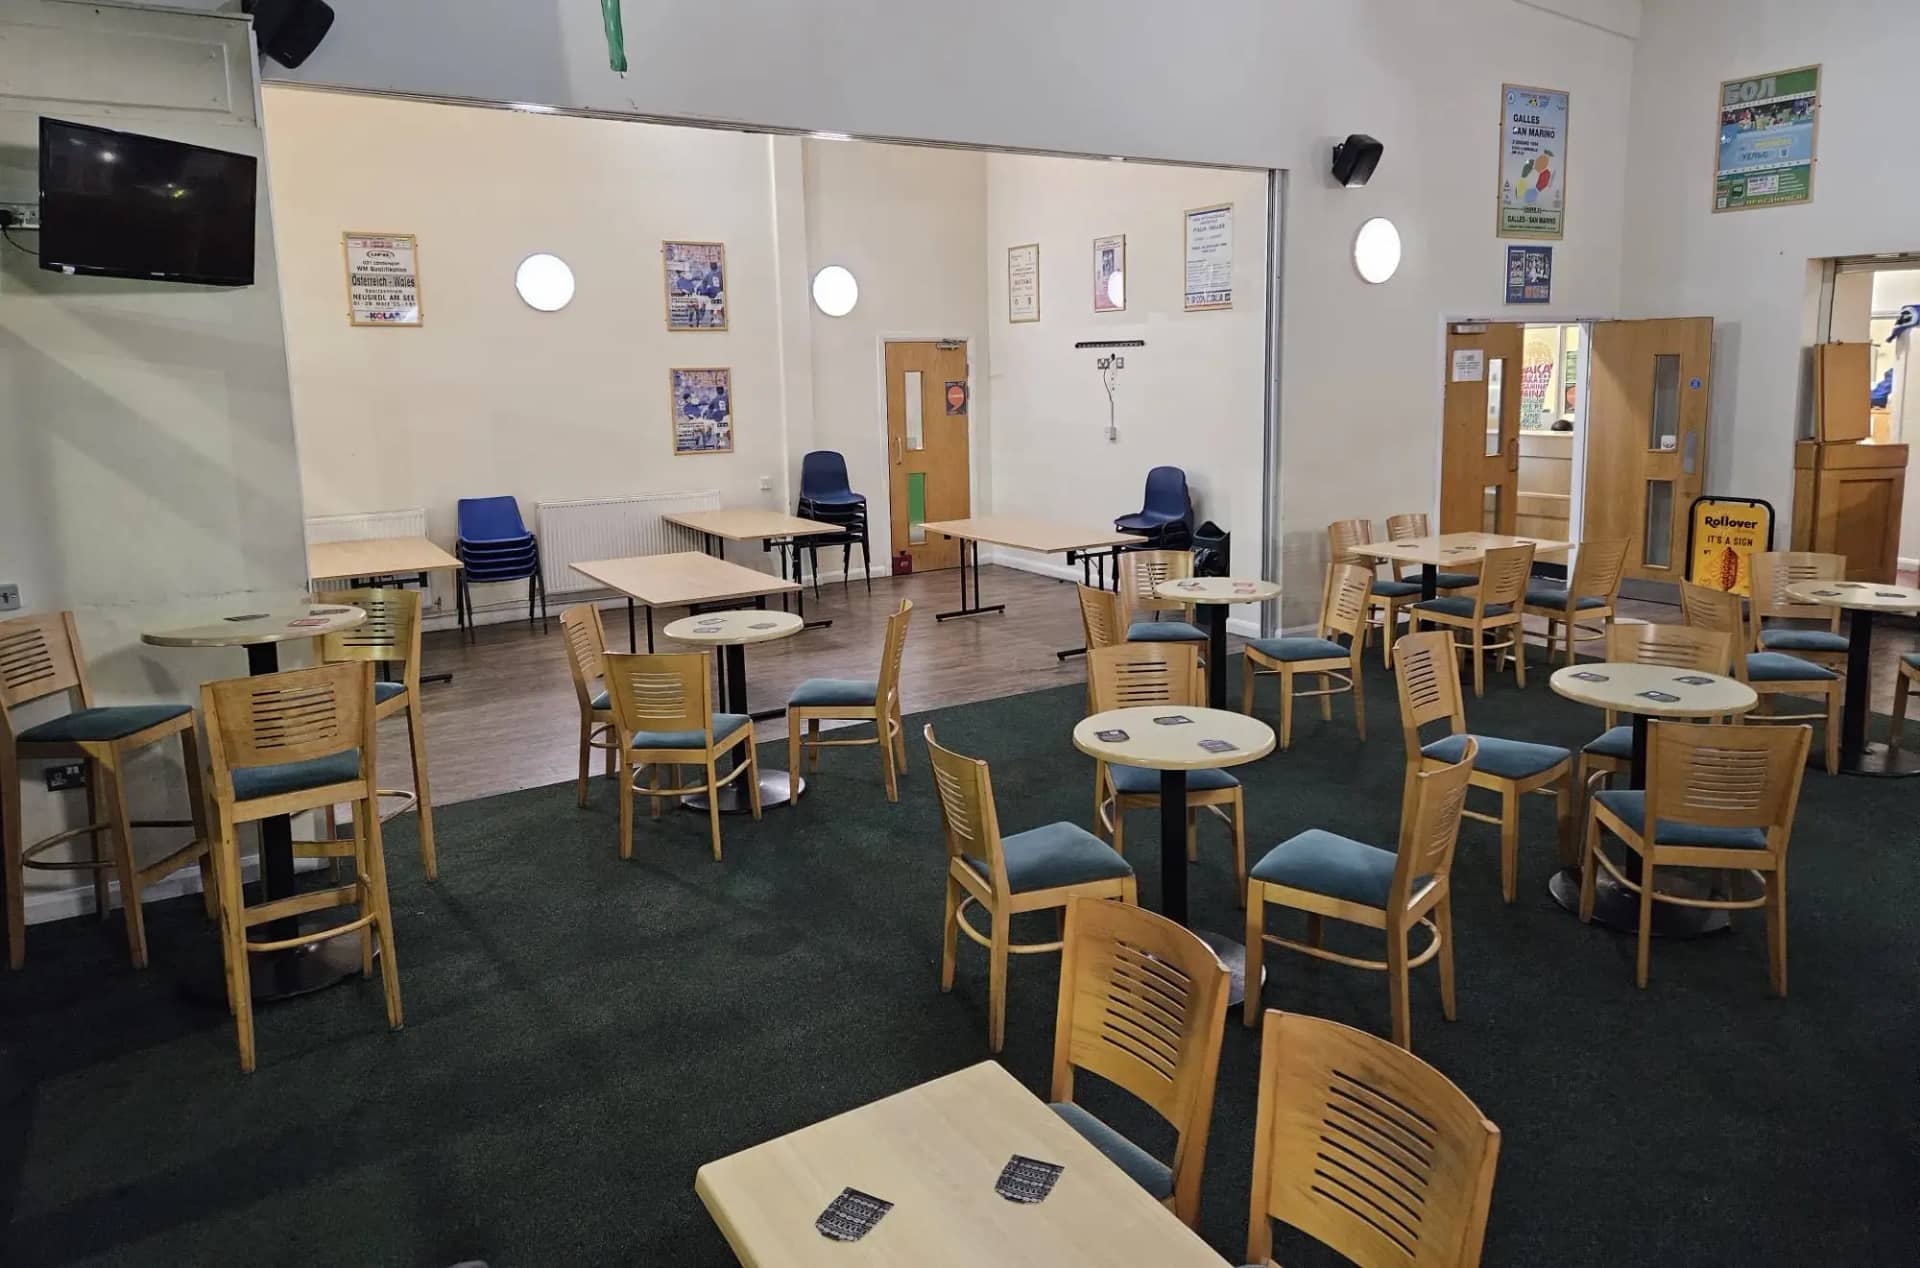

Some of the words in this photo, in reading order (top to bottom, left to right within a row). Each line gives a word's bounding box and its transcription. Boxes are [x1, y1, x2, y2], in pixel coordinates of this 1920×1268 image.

[1513, 114, 1540, 124] GALLES
[1528, 127, 1556, 139] MARINO
[351, 273, 387, 287] Österreich
[394, 276, 415, 288] Wales
[1704, 515, 1758, 529] Rollover
[1707, 535, 1722, 544] IT'S
[1725, 537, 1731, 545] A
[1733, 538, 1753, 547] SIGN
